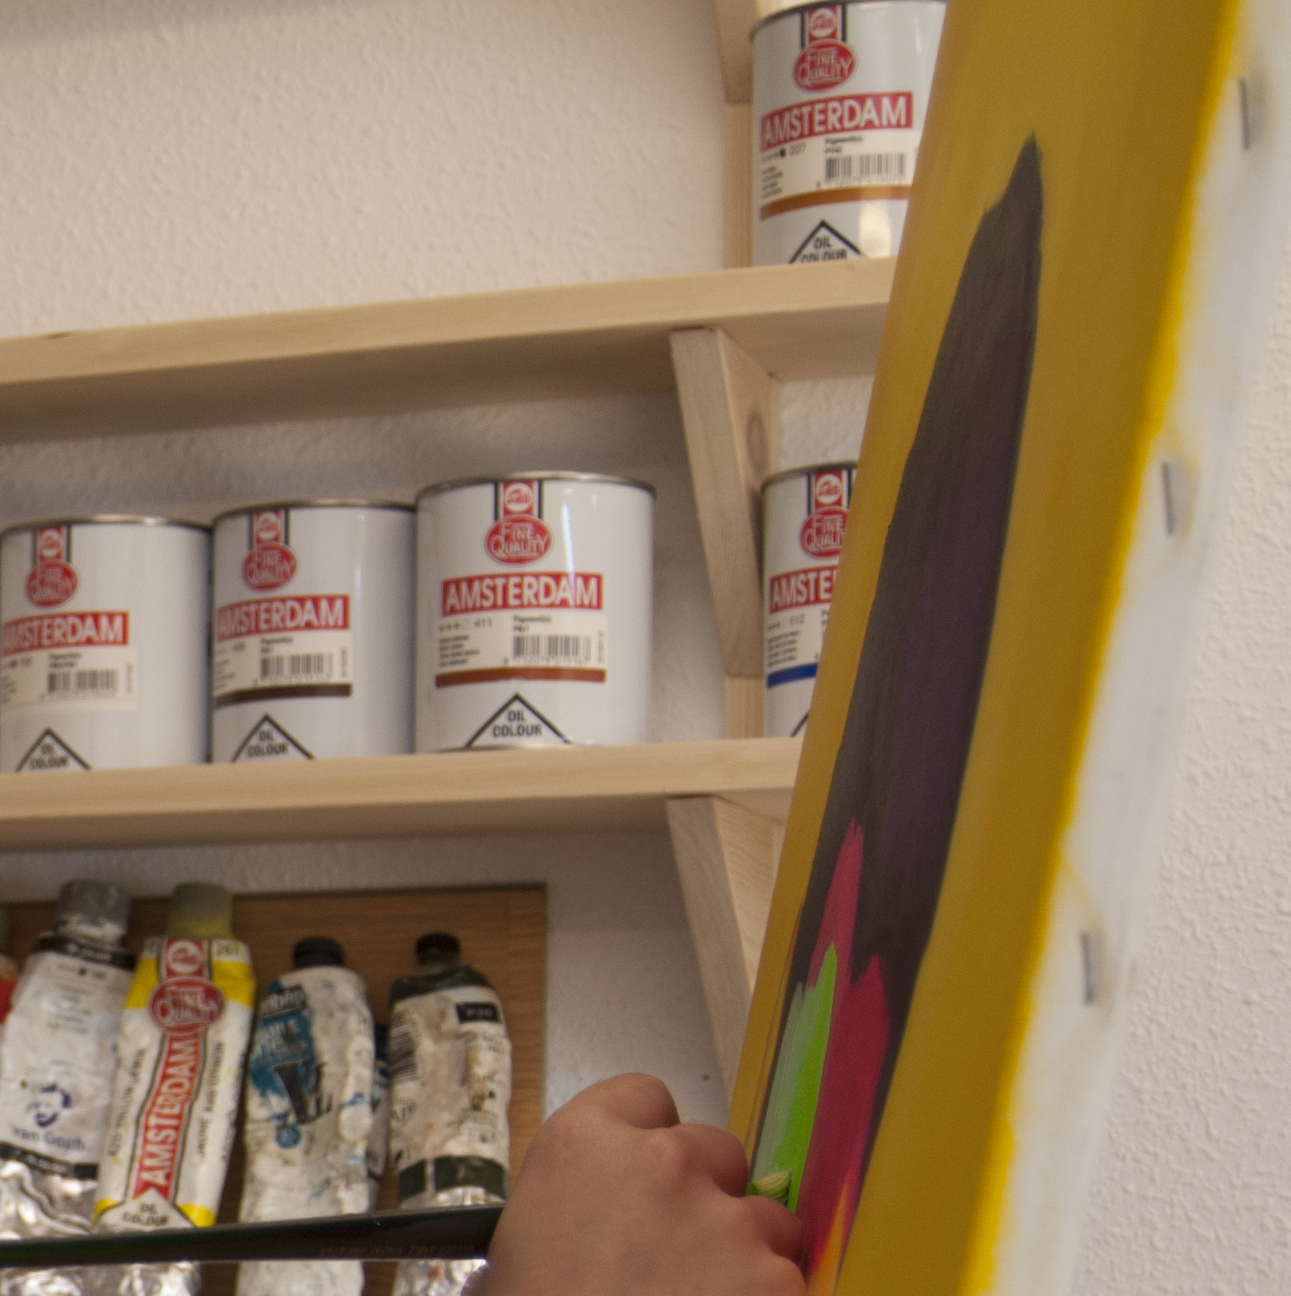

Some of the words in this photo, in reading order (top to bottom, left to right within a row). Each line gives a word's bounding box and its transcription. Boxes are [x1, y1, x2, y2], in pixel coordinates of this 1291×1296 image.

[806, 48, 839, 67] FINE
[799, 58, 853, 86] QUALITY
[763, 96, 907, 149] AMSTERDAM
[813, 237, 833, 249] OIL
[501, 522, 535, 540] FINE
[491, 533, 549, 557] QUALITY
[445, 576, 598, 614] AMSTERDAM
[772, 568, 837, 607] AMSTE
[218, 599, 344, 637] AMSTERDAM
[508, 710, 527, 722] OIL
[492, 724, 542, 738] COLOUR
[138, 1038, 200, 1185] AMSTERDAM
